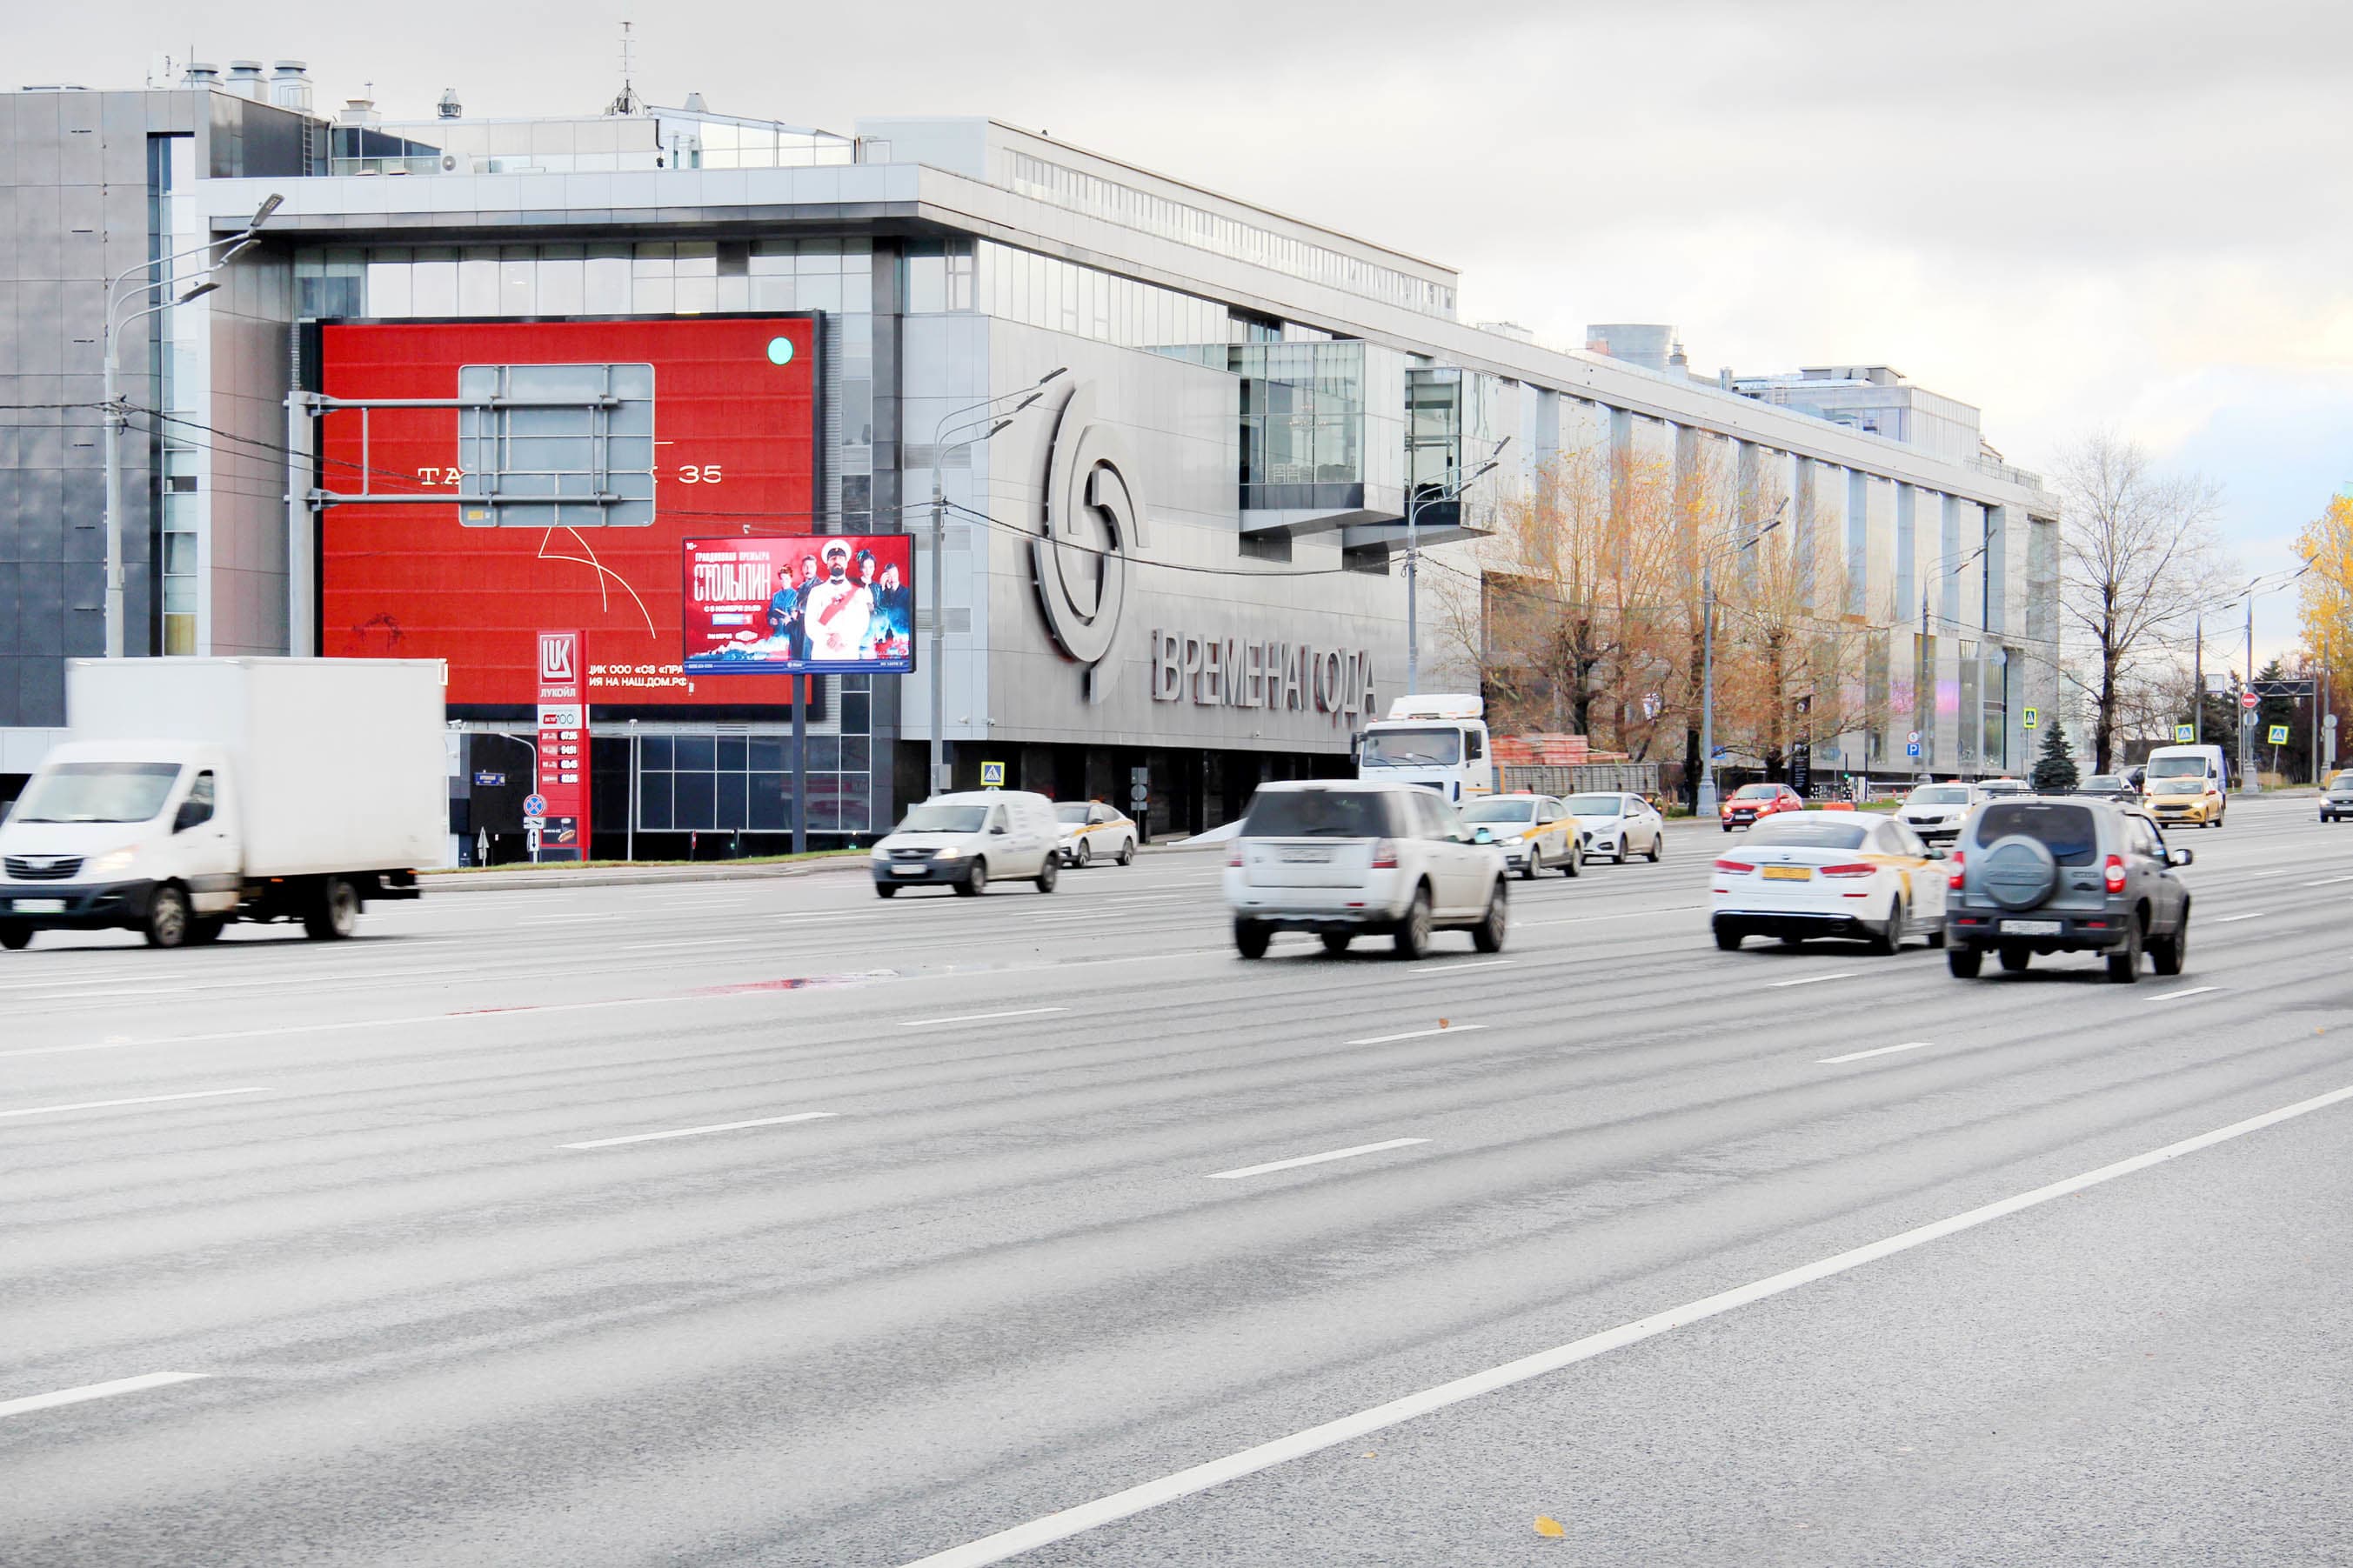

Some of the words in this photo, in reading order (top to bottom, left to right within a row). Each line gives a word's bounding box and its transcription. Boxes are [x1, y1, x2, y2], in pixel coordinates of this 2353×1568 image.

[678, 465, 722, 484] 35
[739, 551, 770, 561] ПРЕМЬЕРА
[693, 564, 772, 602] СТОЛЫПИН
[609, 664, 632, 675] ООО
[658, 664, 683, 675] «ПРА
[589, 677, 603, 686] ИЯ
[605, 677, 619, 686] НА
[621, 677, 687, 688] НАШ.ДОМ.РФ
[1153, 628, 1302, 711] ВРЕМЕНА
[1302, 644, 1377, 728] ГОДА
[540, 686, 576, 697] ЛУКОЙЛ
